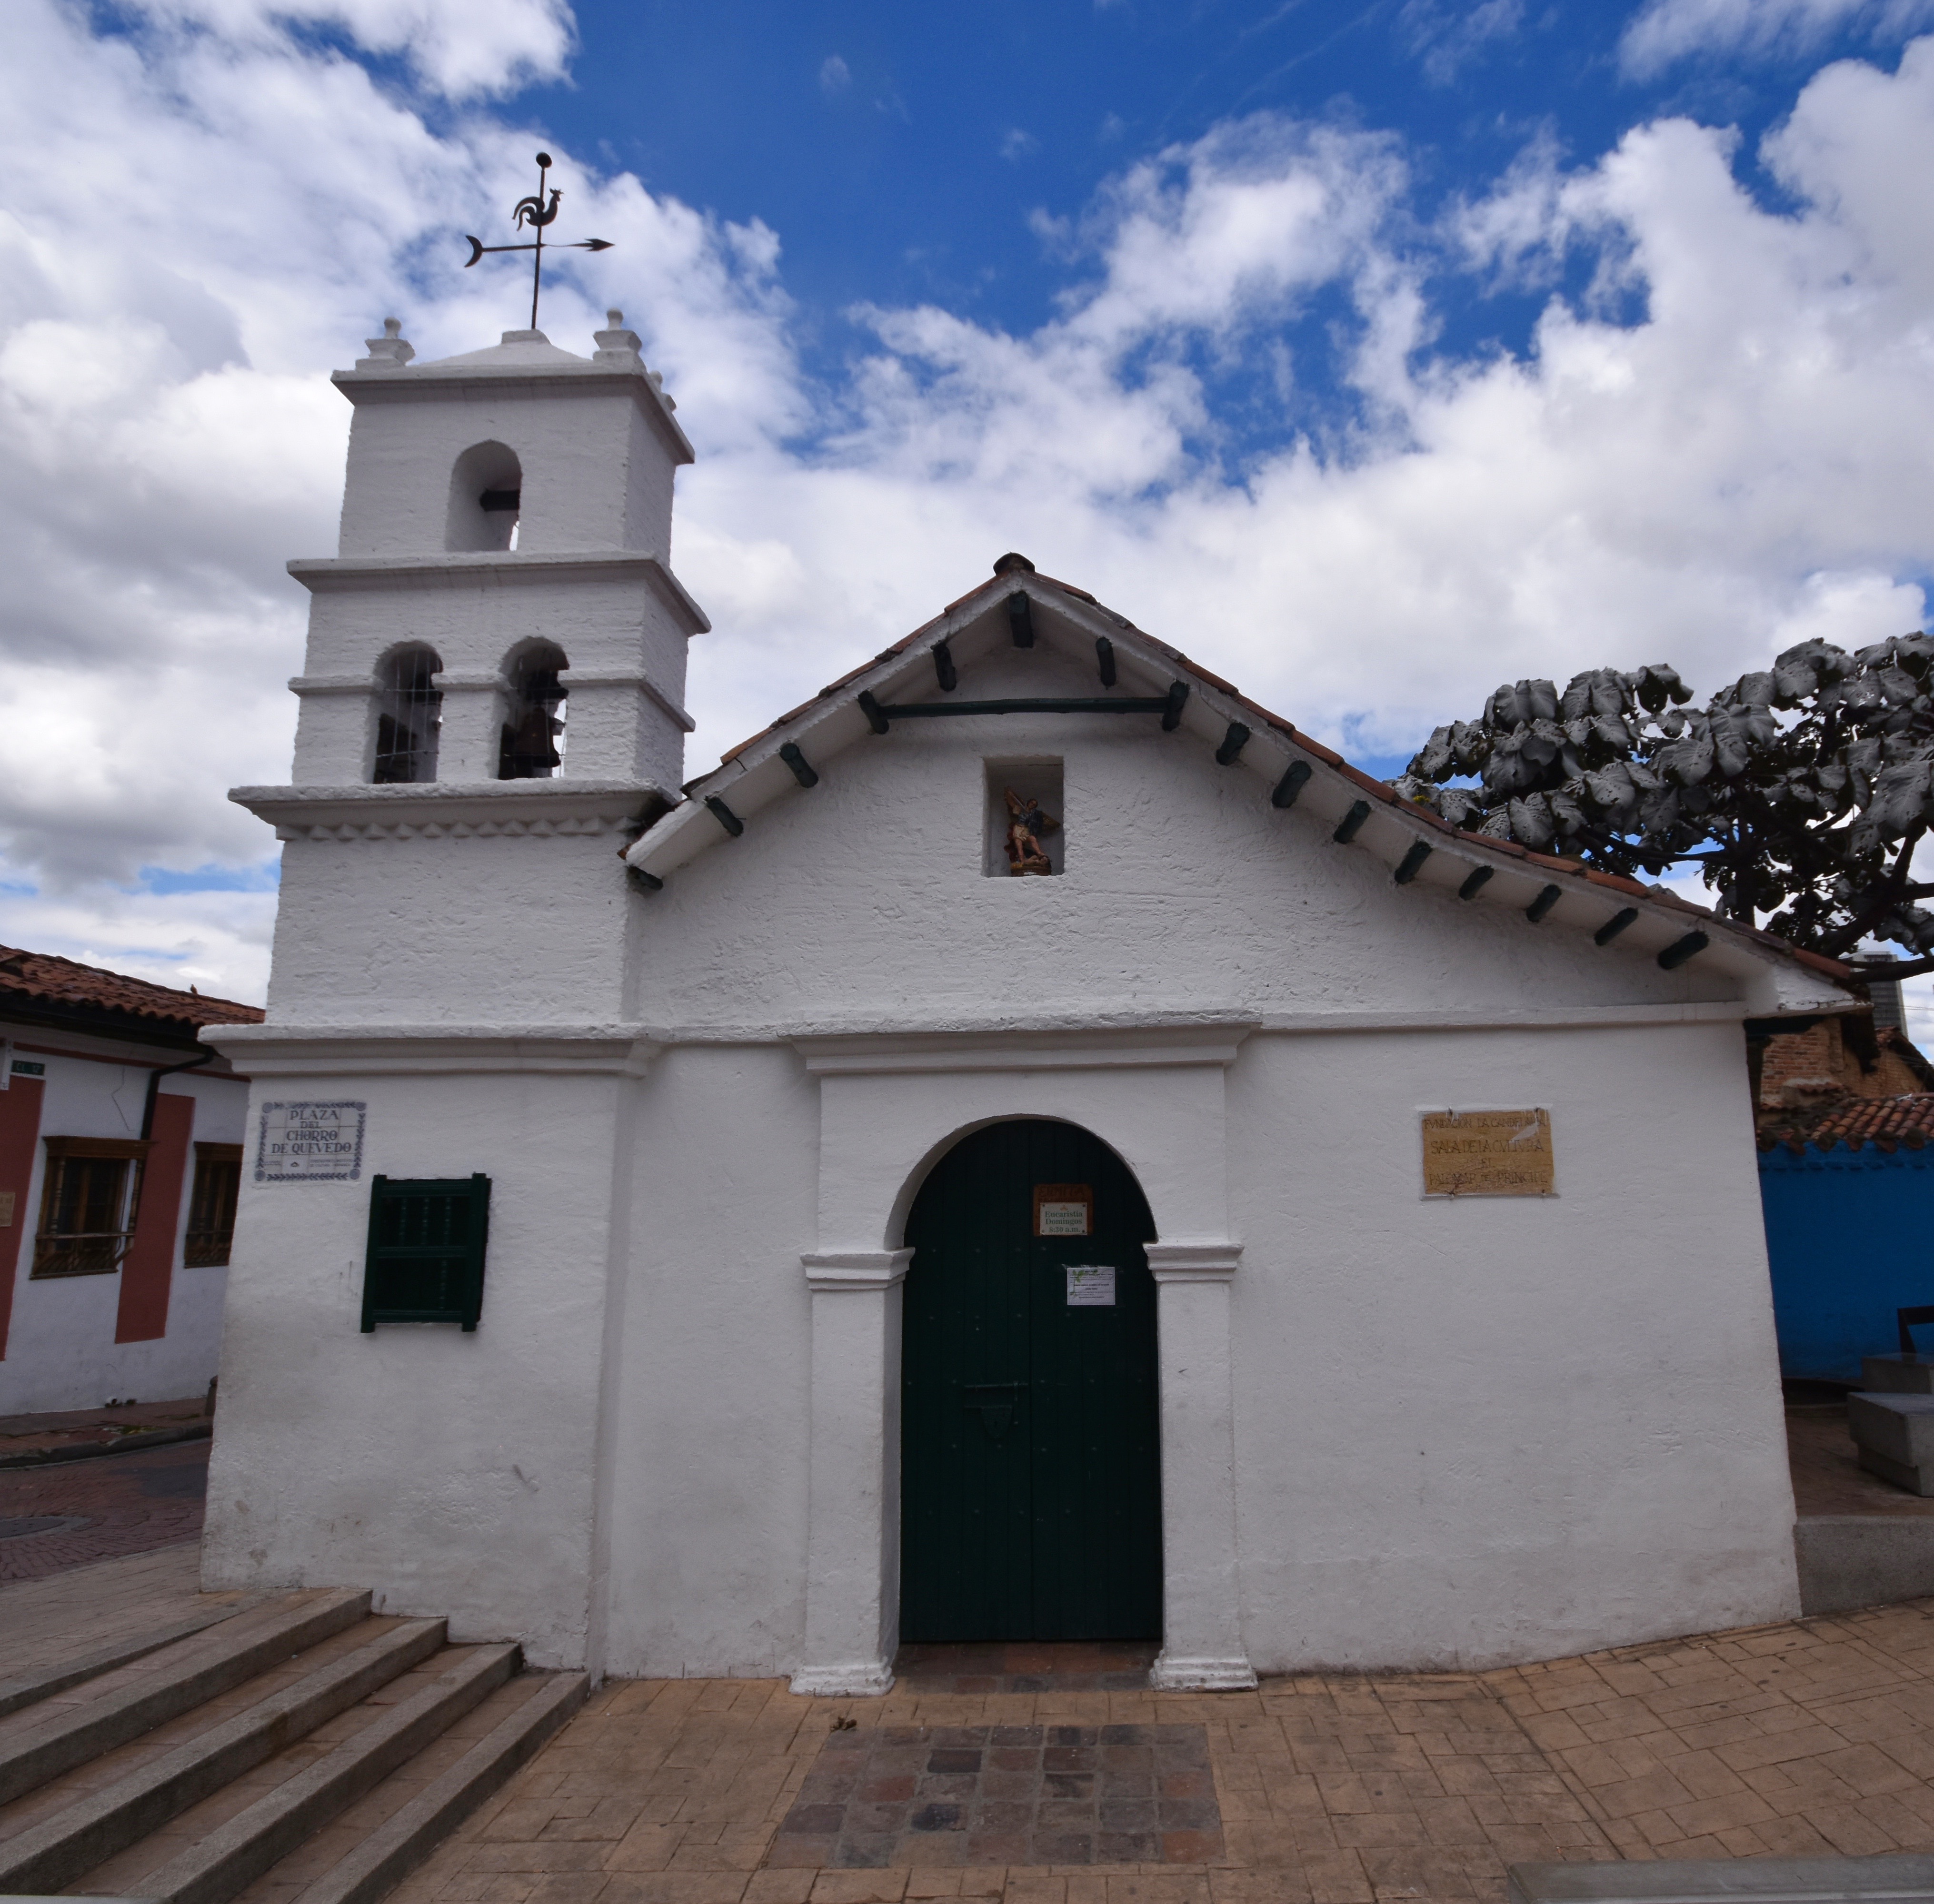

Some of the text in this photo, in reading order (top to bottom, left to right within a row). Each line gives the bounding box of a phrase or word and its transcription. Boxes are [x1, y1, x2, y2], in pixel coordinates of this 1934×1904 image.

[290, 1110, 339, 1120] PLAZA
[1478, 1118, 1490, 1128] LA
[287, 1130, 337, 1141] CHORRO
[272, 1142, 351, 1155] DE QUEVEDO
[1431, 1140, 1461, 1154] SALA
[1463, 1140, 1478, 1152] DE
[1482, 1159, 1495, 1168] EL
